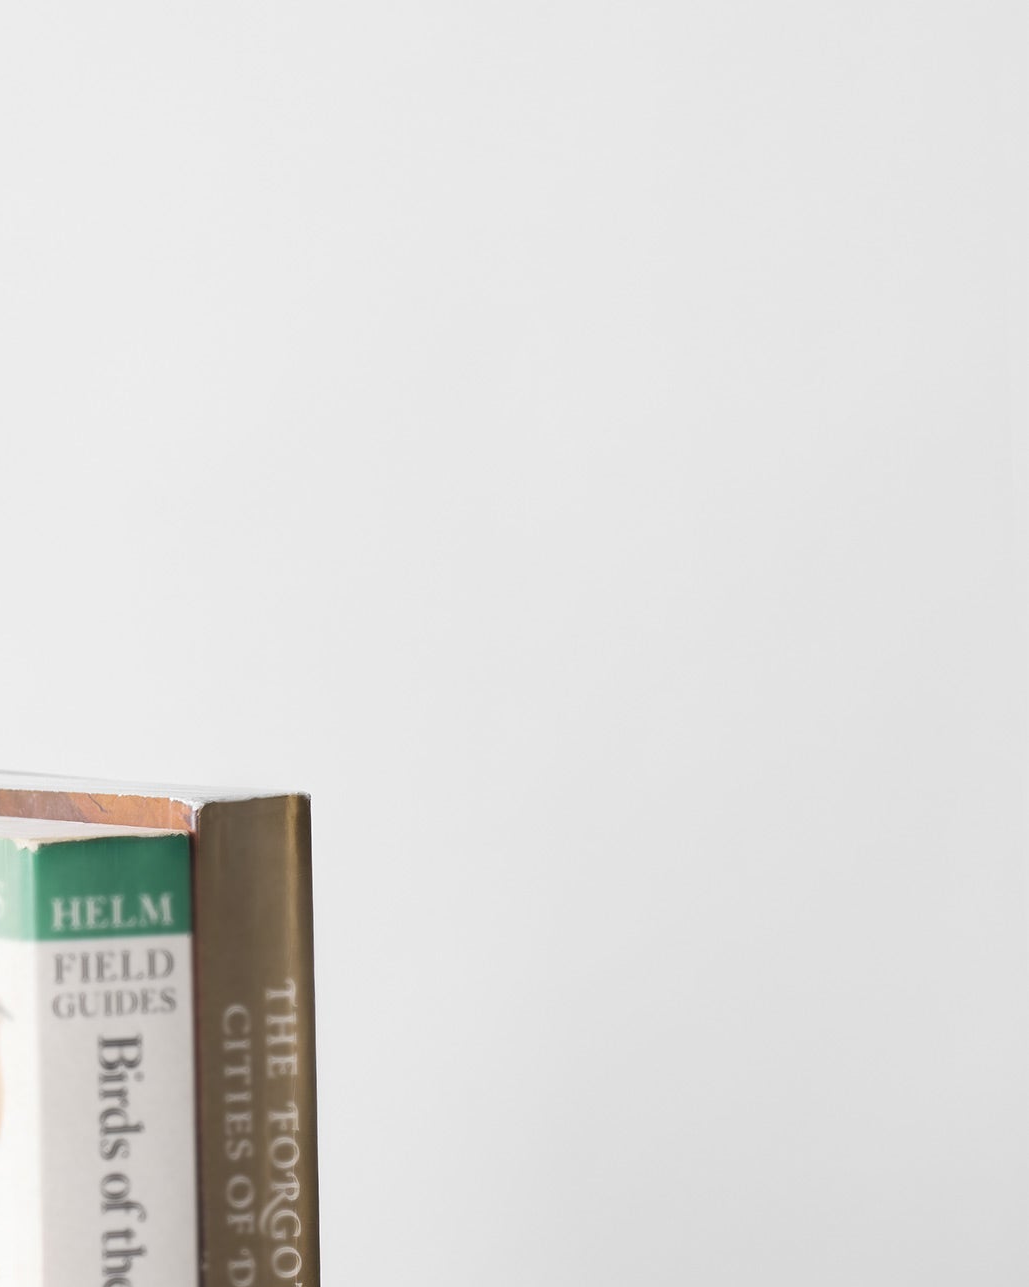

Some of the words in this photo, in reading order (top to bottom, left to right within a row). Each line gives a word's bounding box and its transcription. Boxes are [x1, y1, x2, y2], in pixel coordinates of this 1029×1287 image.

[52, 892, 173, 931] HELM
[54, 948, 175, 984] FIELD
[52, 987, 177, 1019] GUIDES
[265, 976, 298, 1080] THE
[96, 1033, 144, 1160] Birds
[223, 1004, 252, 1161] CITIES
[99, 1171, 147, 1221] of
[226, 1174, 255, 1236] OF
